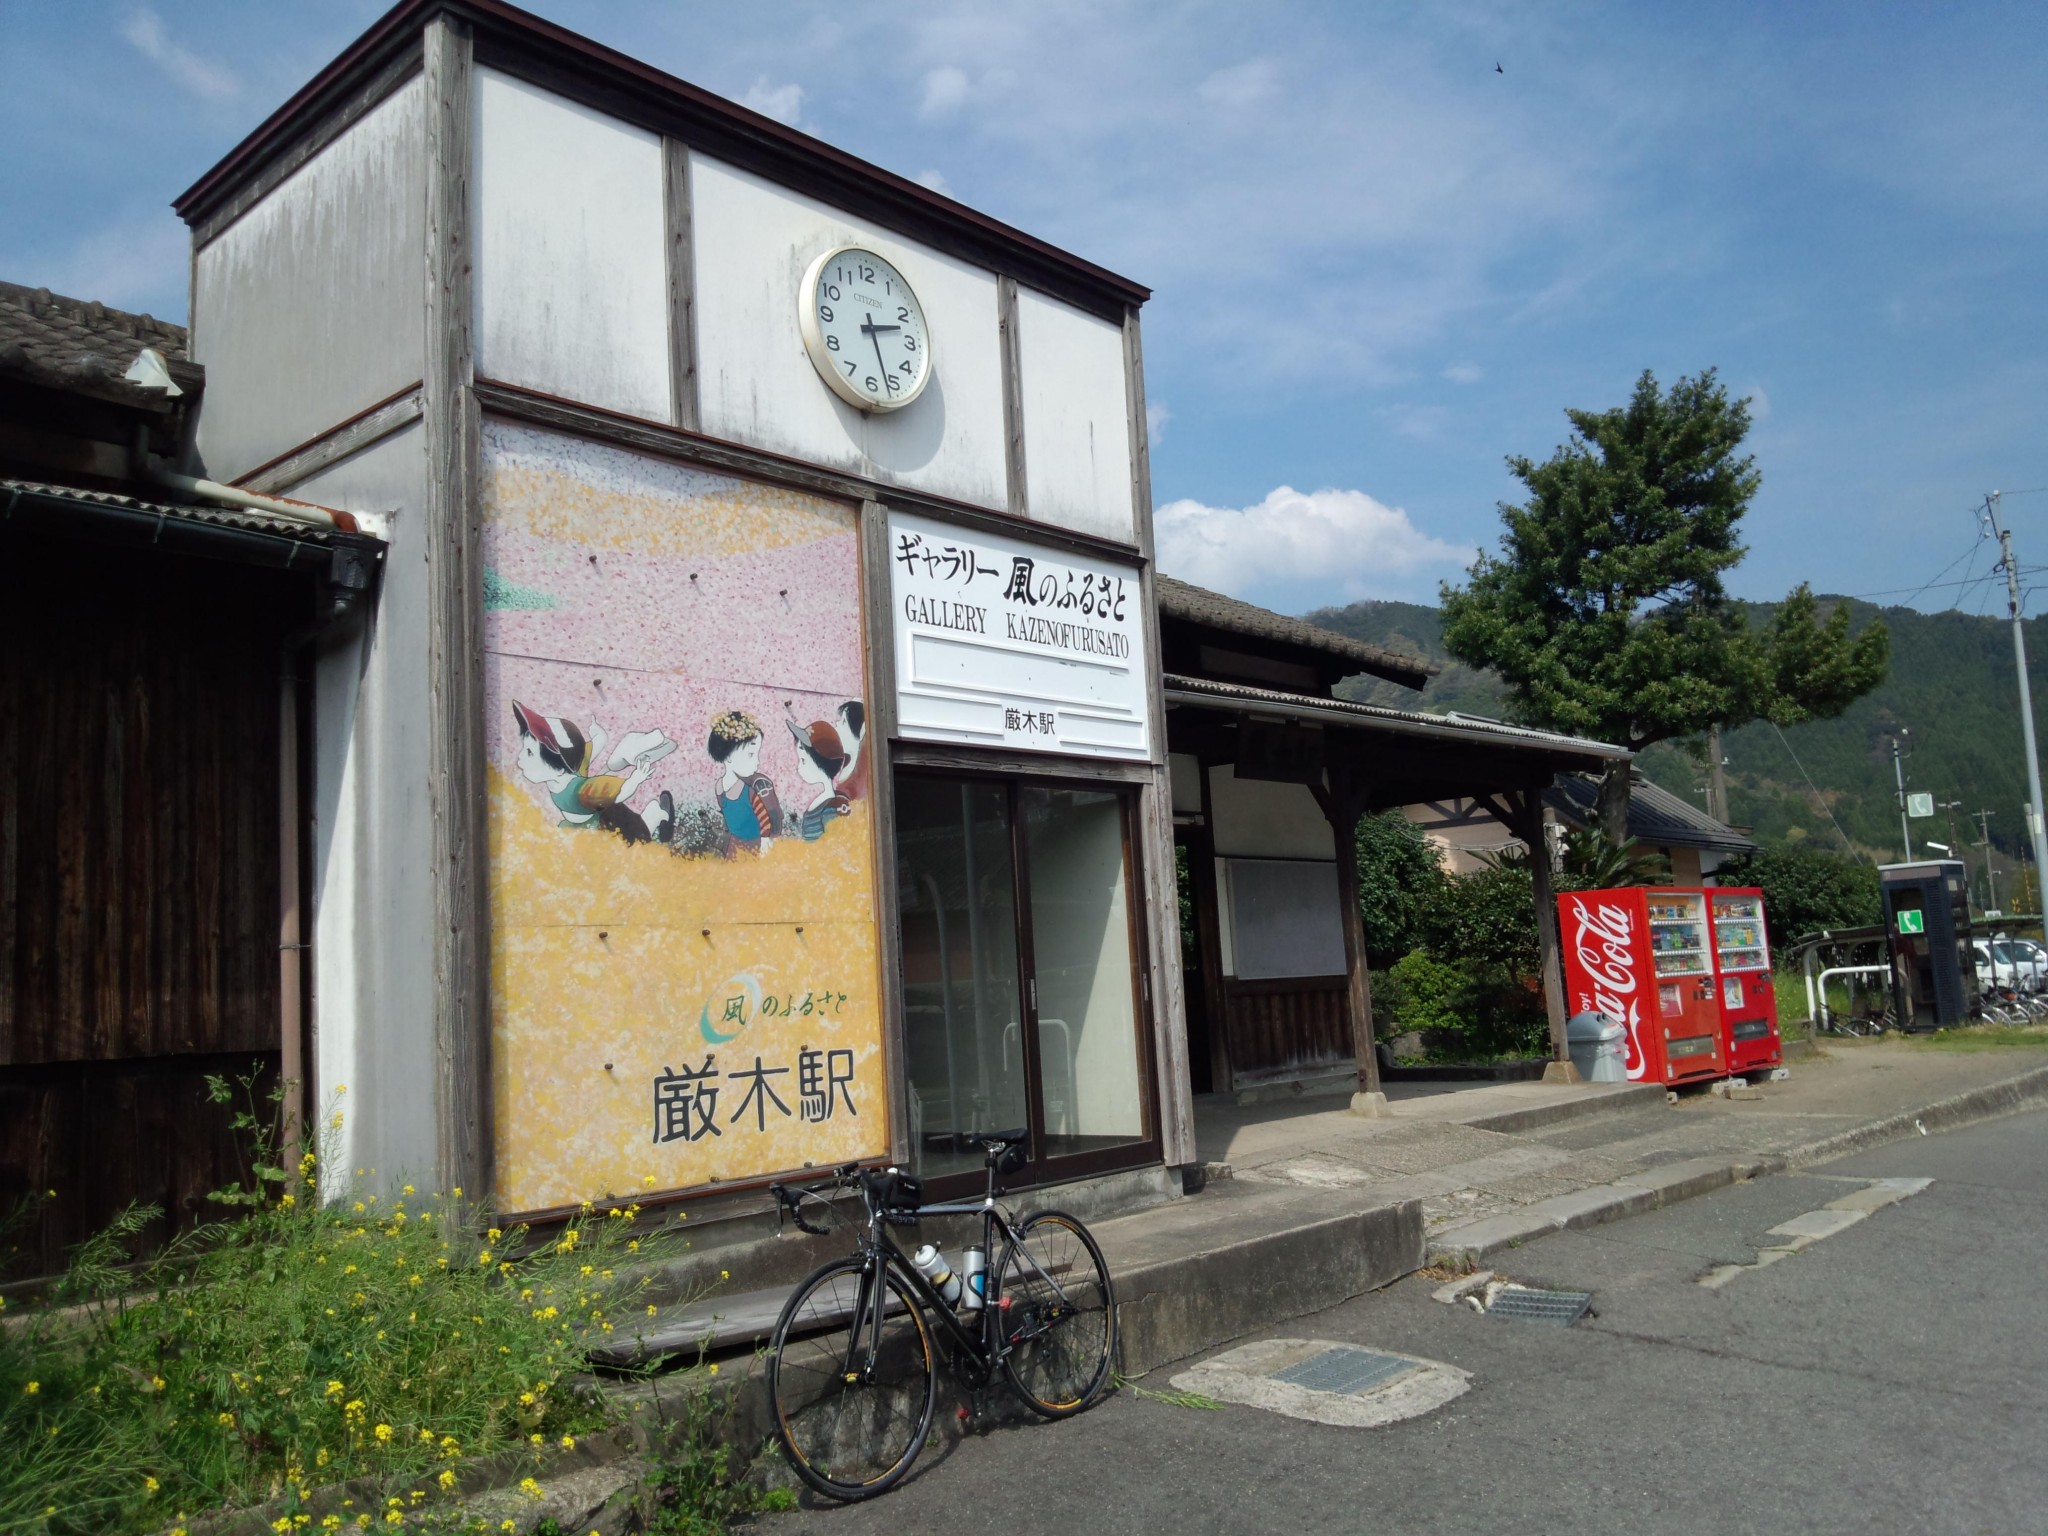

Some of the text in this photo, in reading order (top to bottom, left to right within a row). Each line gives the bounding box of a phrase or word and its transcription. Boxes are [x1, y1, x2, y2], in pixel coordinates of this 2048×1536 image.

[837, 267, 852, 286] 11
[858, 265, 875, 284] 12
[822, 282, 841, 301] 10
[885, 281, 890, 296] 1
[853, 293, 883, 309] CITIZEN
[820, 305, 834, 322] 9
[897, 306, 909, 323] 2
[826, 335, 840, 351] 8
[904, 335, 916, 351] 3
[844, 360, 857, 376] 7
[899, 360, 912, 375] 4
[865, 376, 878, 392] 6
[887, 375, 900, 391] 5
[905, 594, 1129, 659] GALLERY KAZENOFURUSATO
[1005, 707, 1056, 735] 厳木駅
[722, 990, 847, 1025] 風のふるさと
[652, 1049, 857, 1144] 厳木駅
